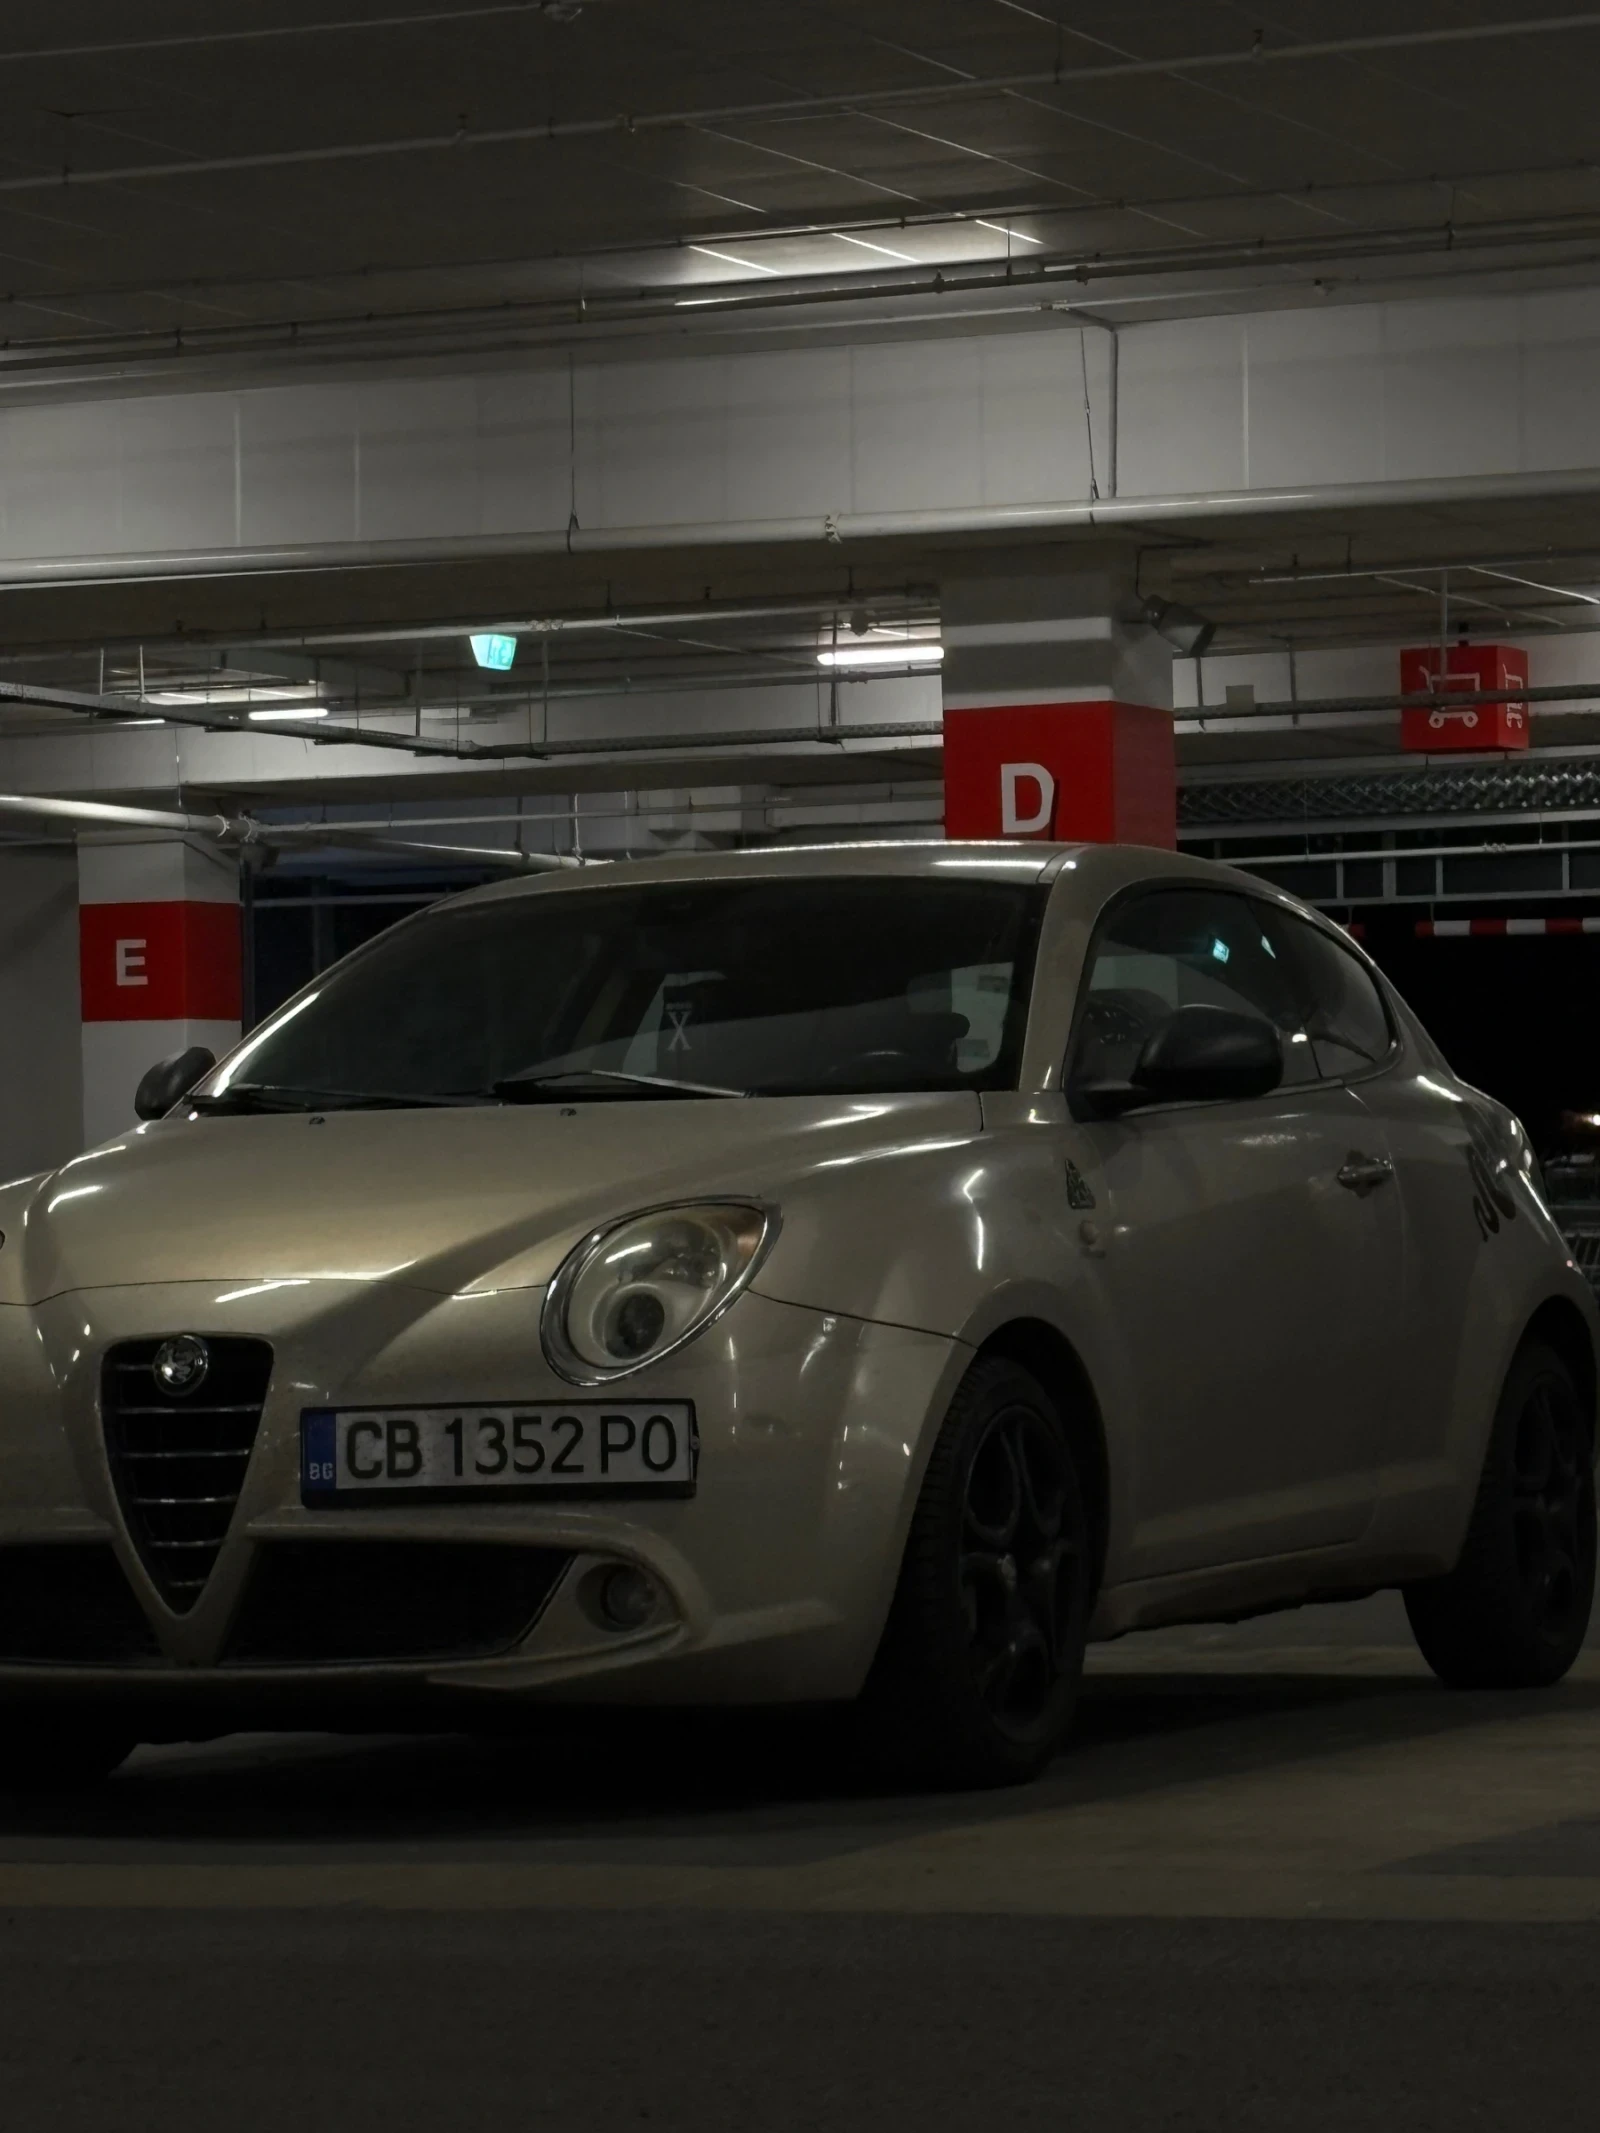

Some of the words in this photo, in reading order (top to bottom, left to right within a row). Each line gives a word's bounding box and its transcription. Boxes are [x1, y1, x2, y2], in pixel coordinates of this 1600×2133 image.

[1001, 763, 1055, 833] D
[116, 939, 149, 986] E
[308, 1464, 334, 1481] BG
[346, 1420, 423, 1479] CB
[445, 1416, 584, 1476] 1352
[600, 1415, 678, 1474] PO
